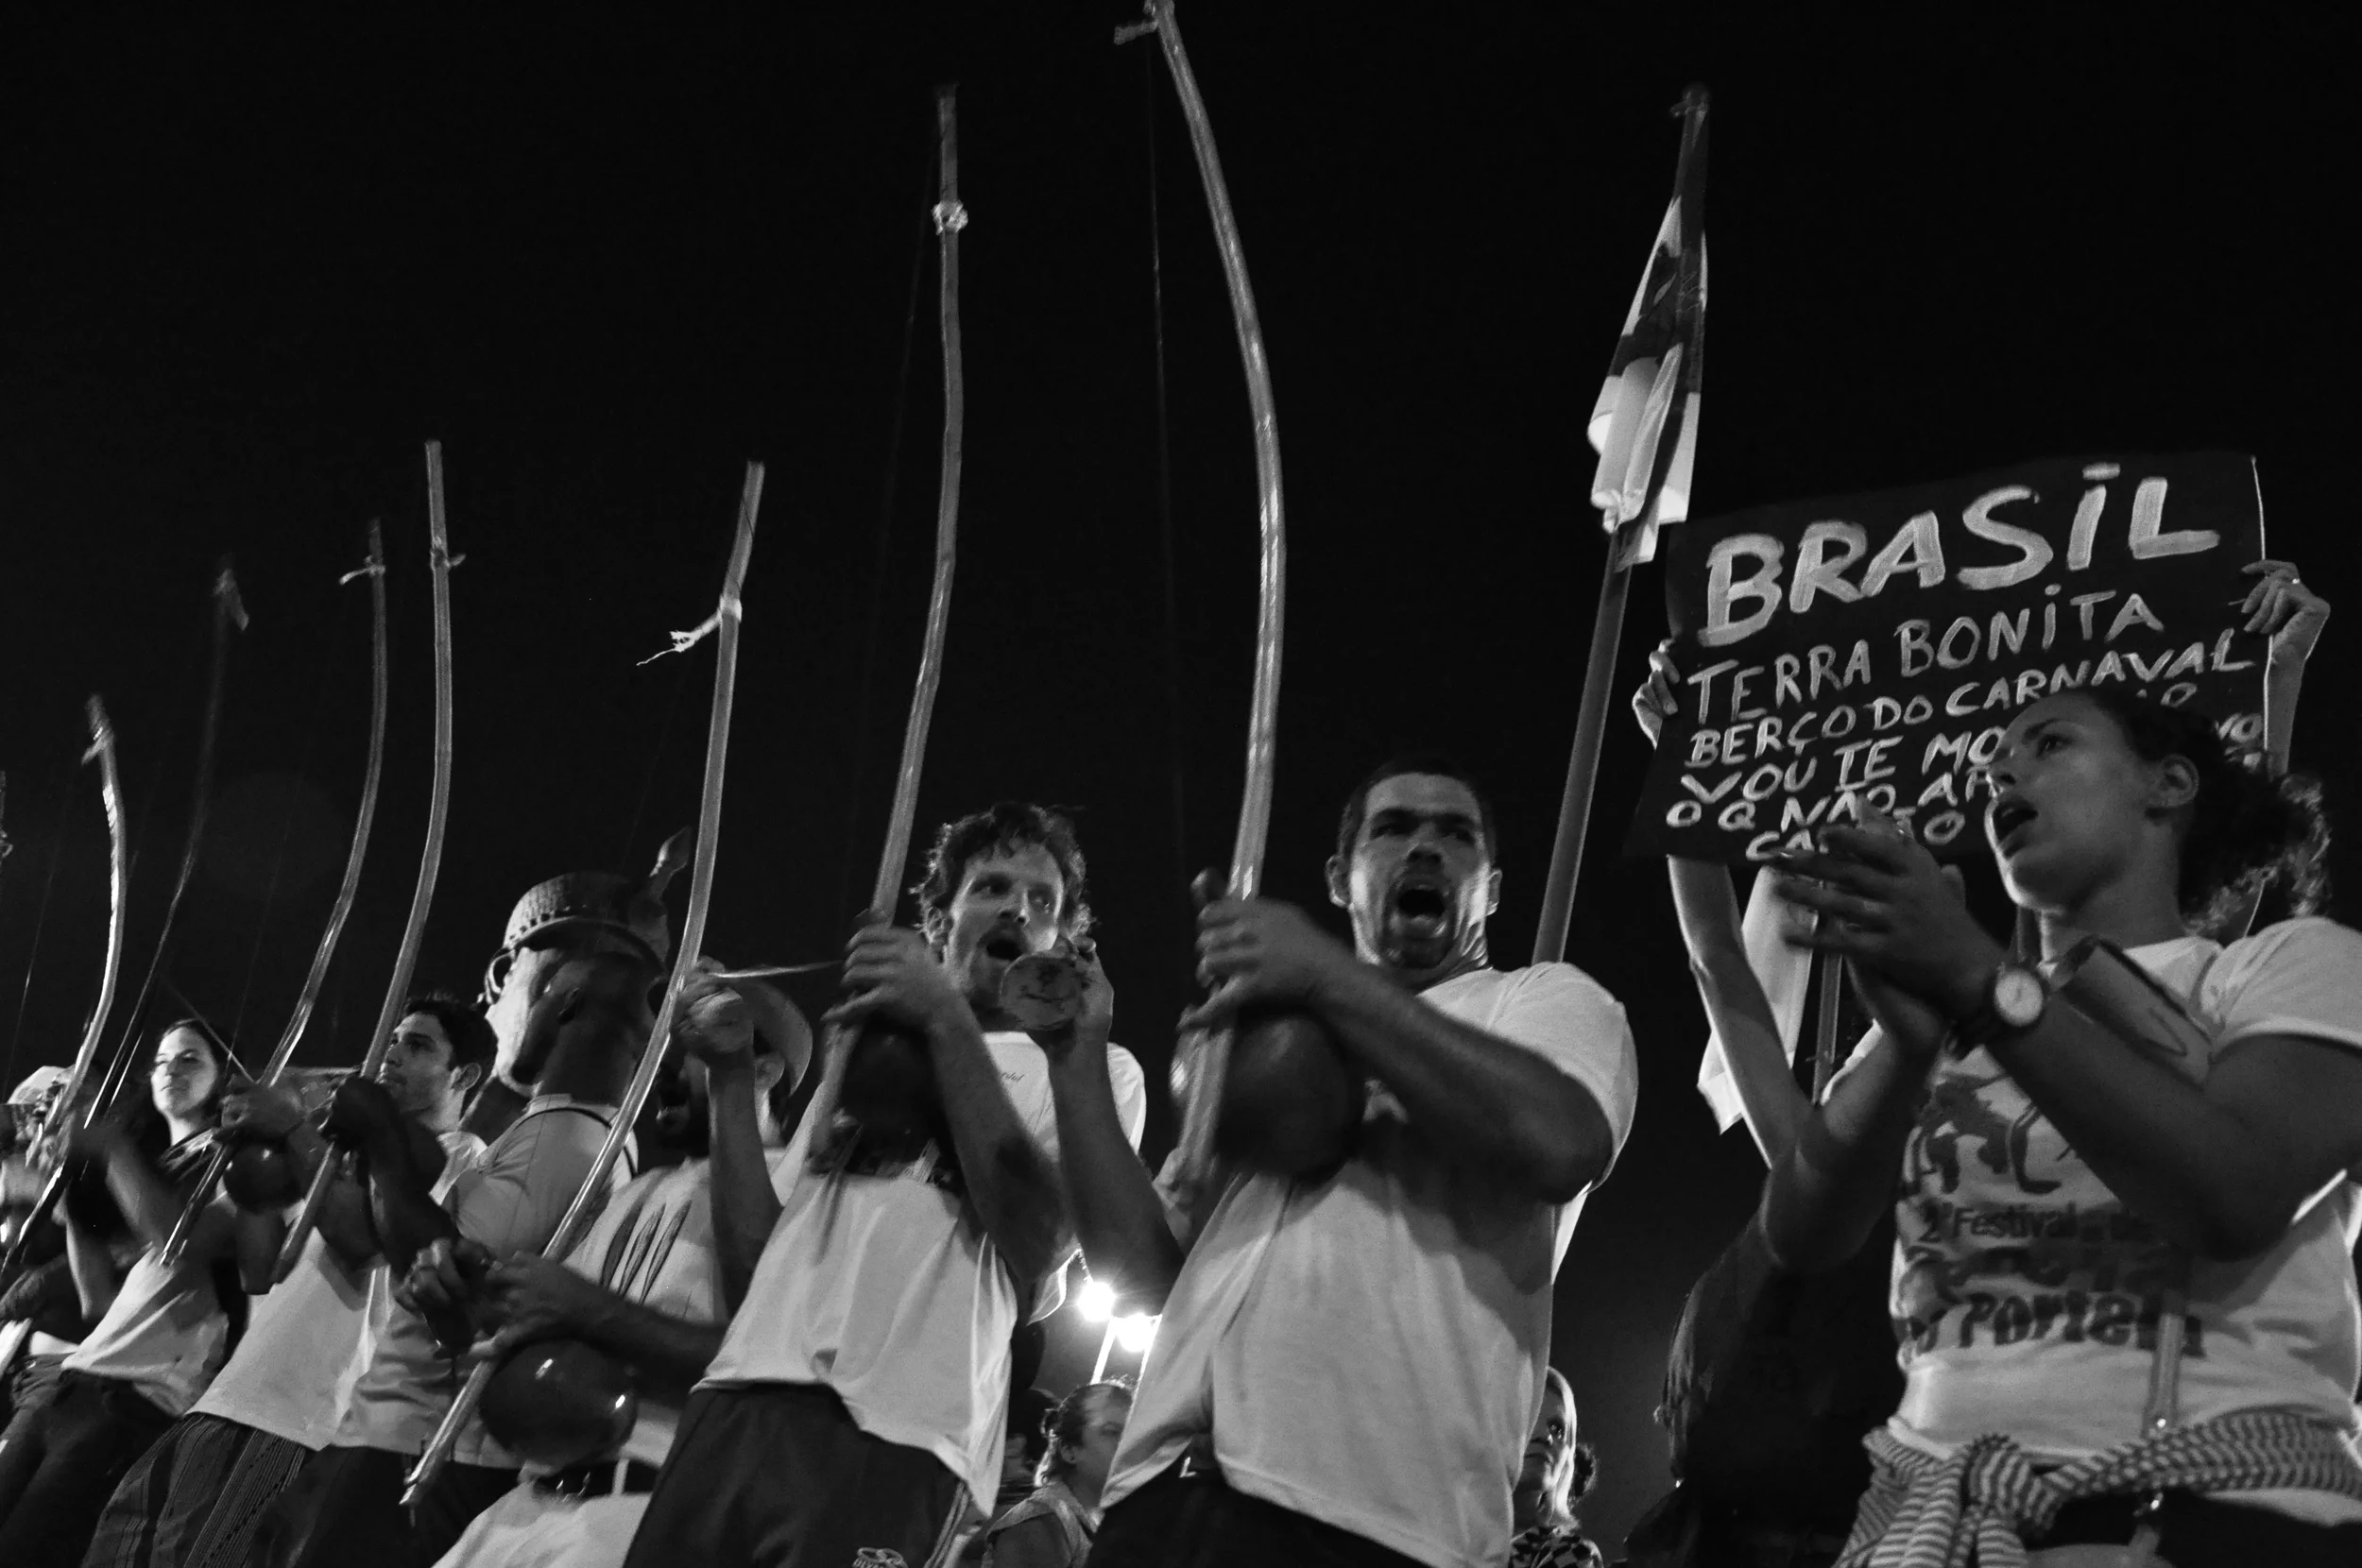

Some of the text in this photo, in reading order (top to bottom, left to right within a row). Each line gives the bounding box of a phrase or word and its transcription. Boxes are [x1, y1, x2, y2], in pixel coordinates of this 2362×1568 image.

[1686, 639, 1872, 725] TERRA
[1862, 694, 1934, 731] DO
[1944, 628, 2255, 716] CARNAVAL
[1680, 756, 1818, 804] VOU
[1833, 735, 1904, 788] TE
[1666, 800, 1703, 828] O
[1718, 801, 1756, 831] Q
